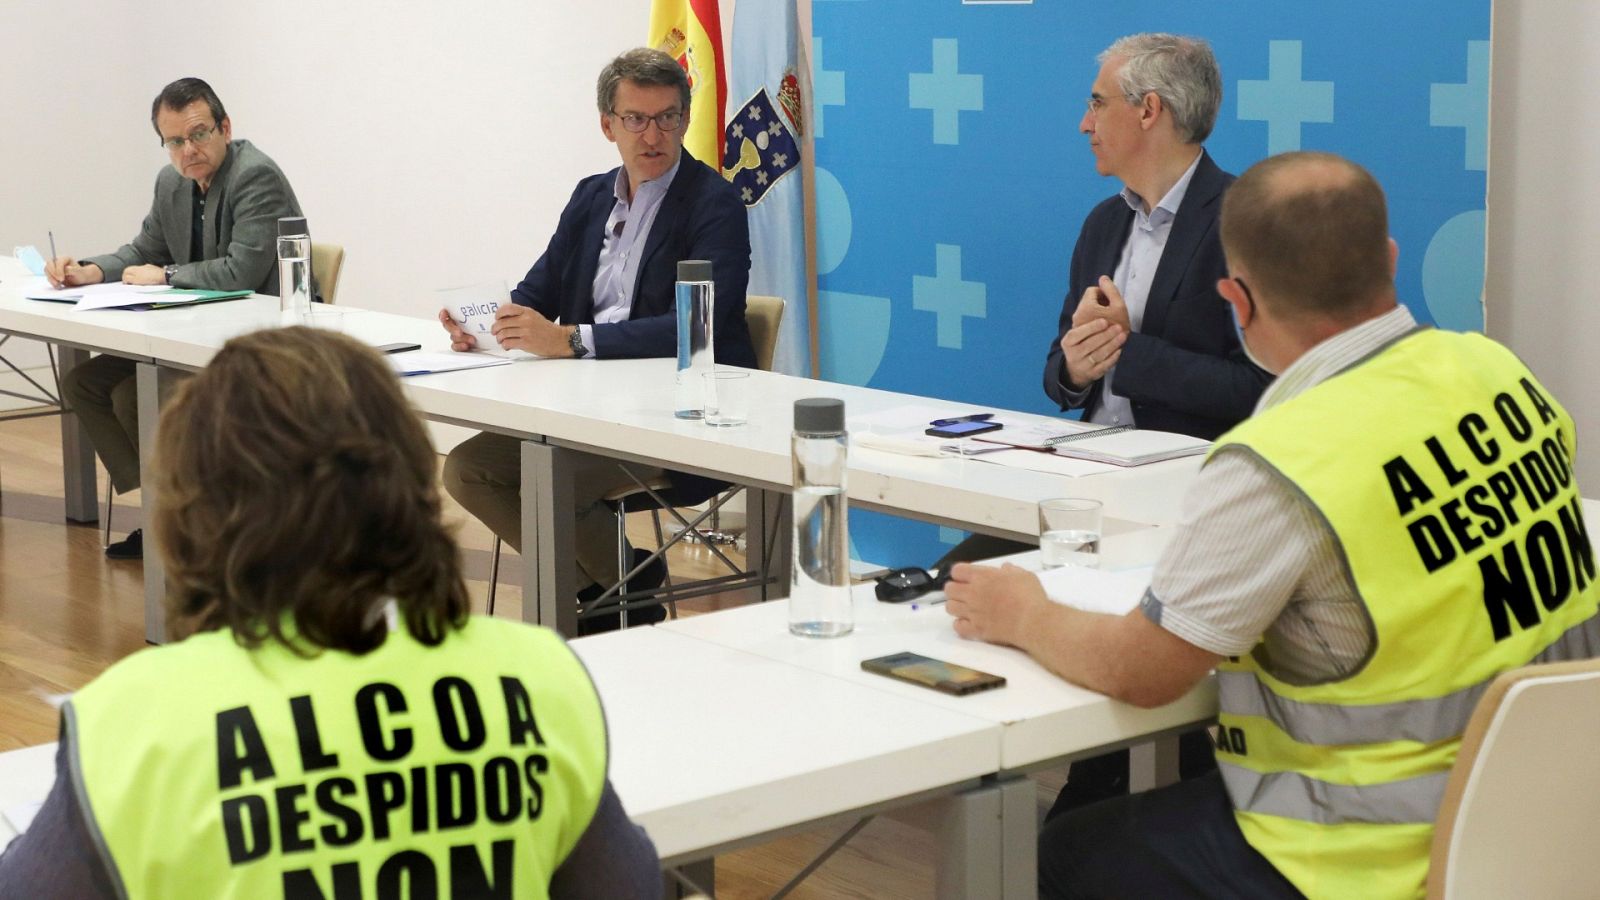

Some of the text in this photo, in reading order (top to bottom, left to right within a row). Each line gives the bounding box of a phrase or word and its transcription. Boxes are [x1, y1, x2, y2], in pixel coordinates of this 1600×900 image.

[459, 302, 499, 324] galicia
[1382, 377, 1557, 517] ALCOA
[1478, 494, 1596, 643] NON
[216, 675, 546, 790] ALCOA
[221, 754, 549, 867] DESPIDOS
